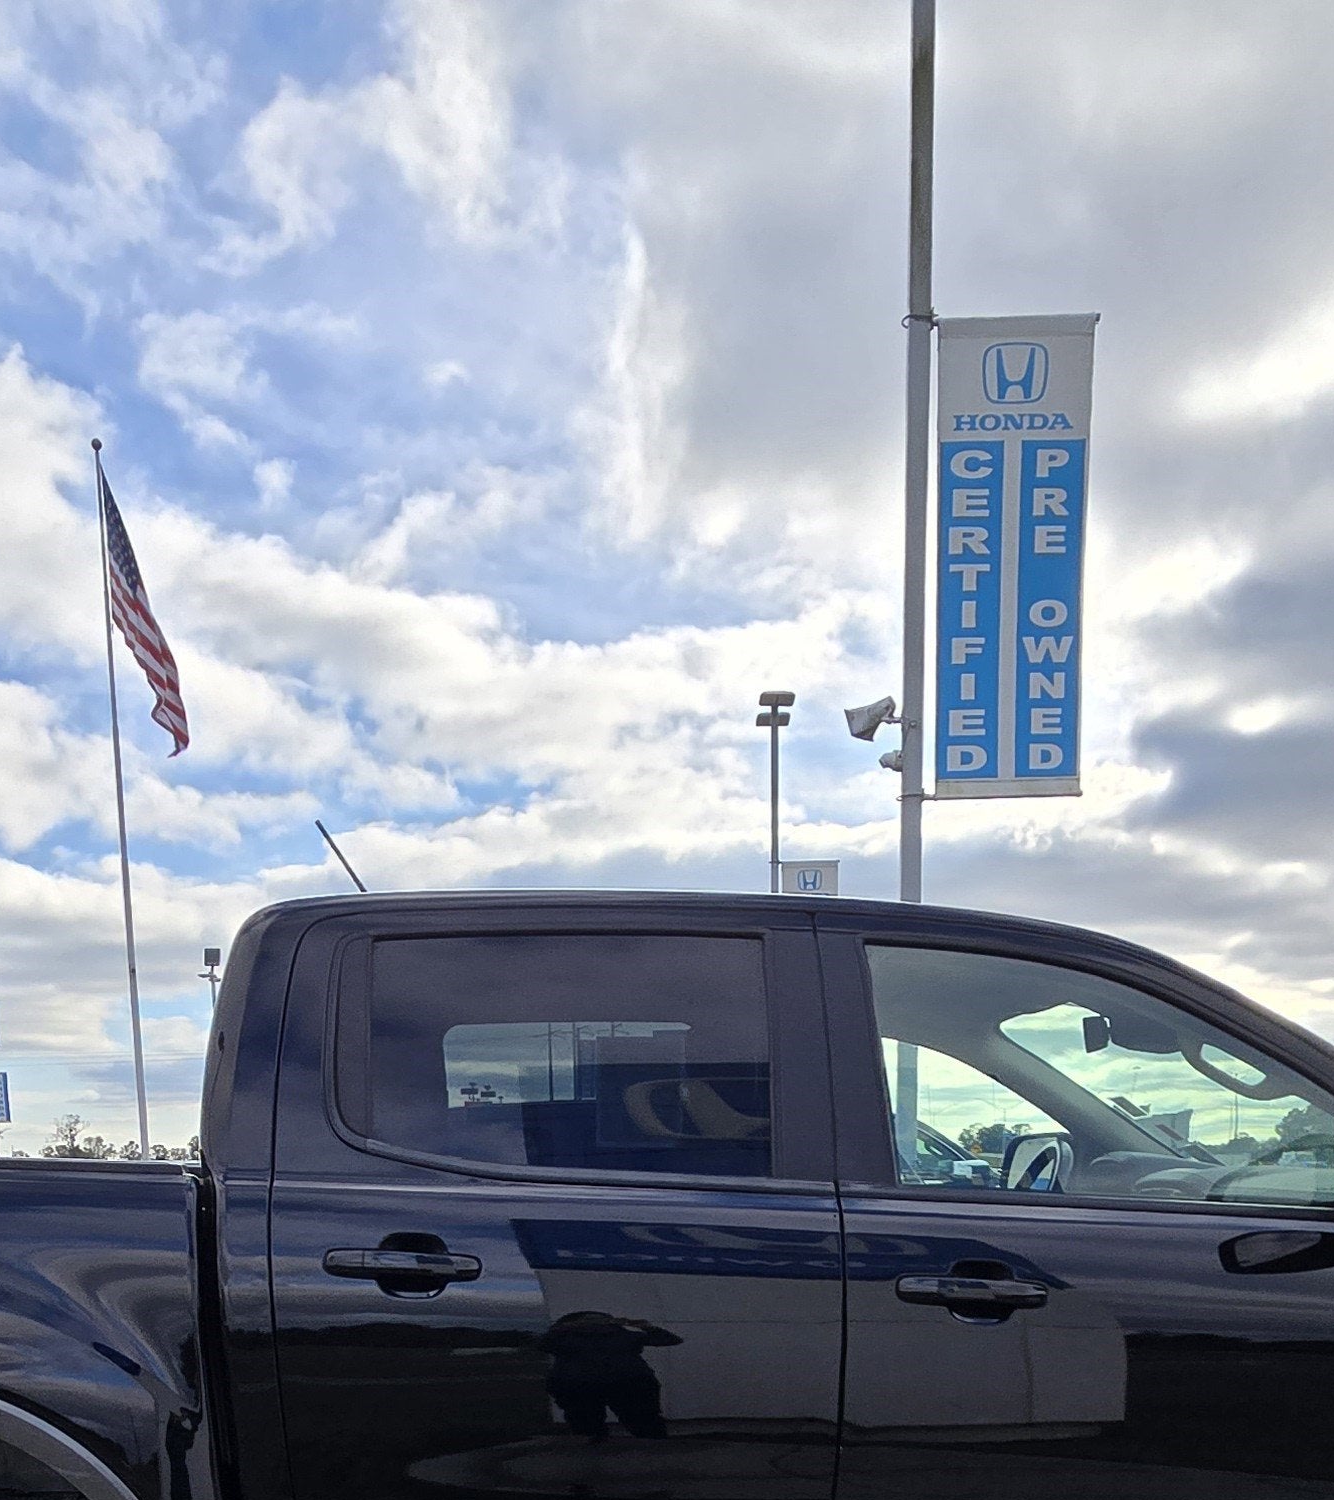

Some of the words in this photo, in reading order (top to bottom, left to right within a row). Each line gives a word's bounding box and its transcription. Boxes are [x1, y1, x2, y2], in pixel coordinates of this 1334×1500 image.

[952, 412, 1074, 433] HONDA
[1031, 448, 1070, 555] PRE
[946, 449, 995, 773] CERTIFIED
[1022, 599, 1074, 772] OWNED
